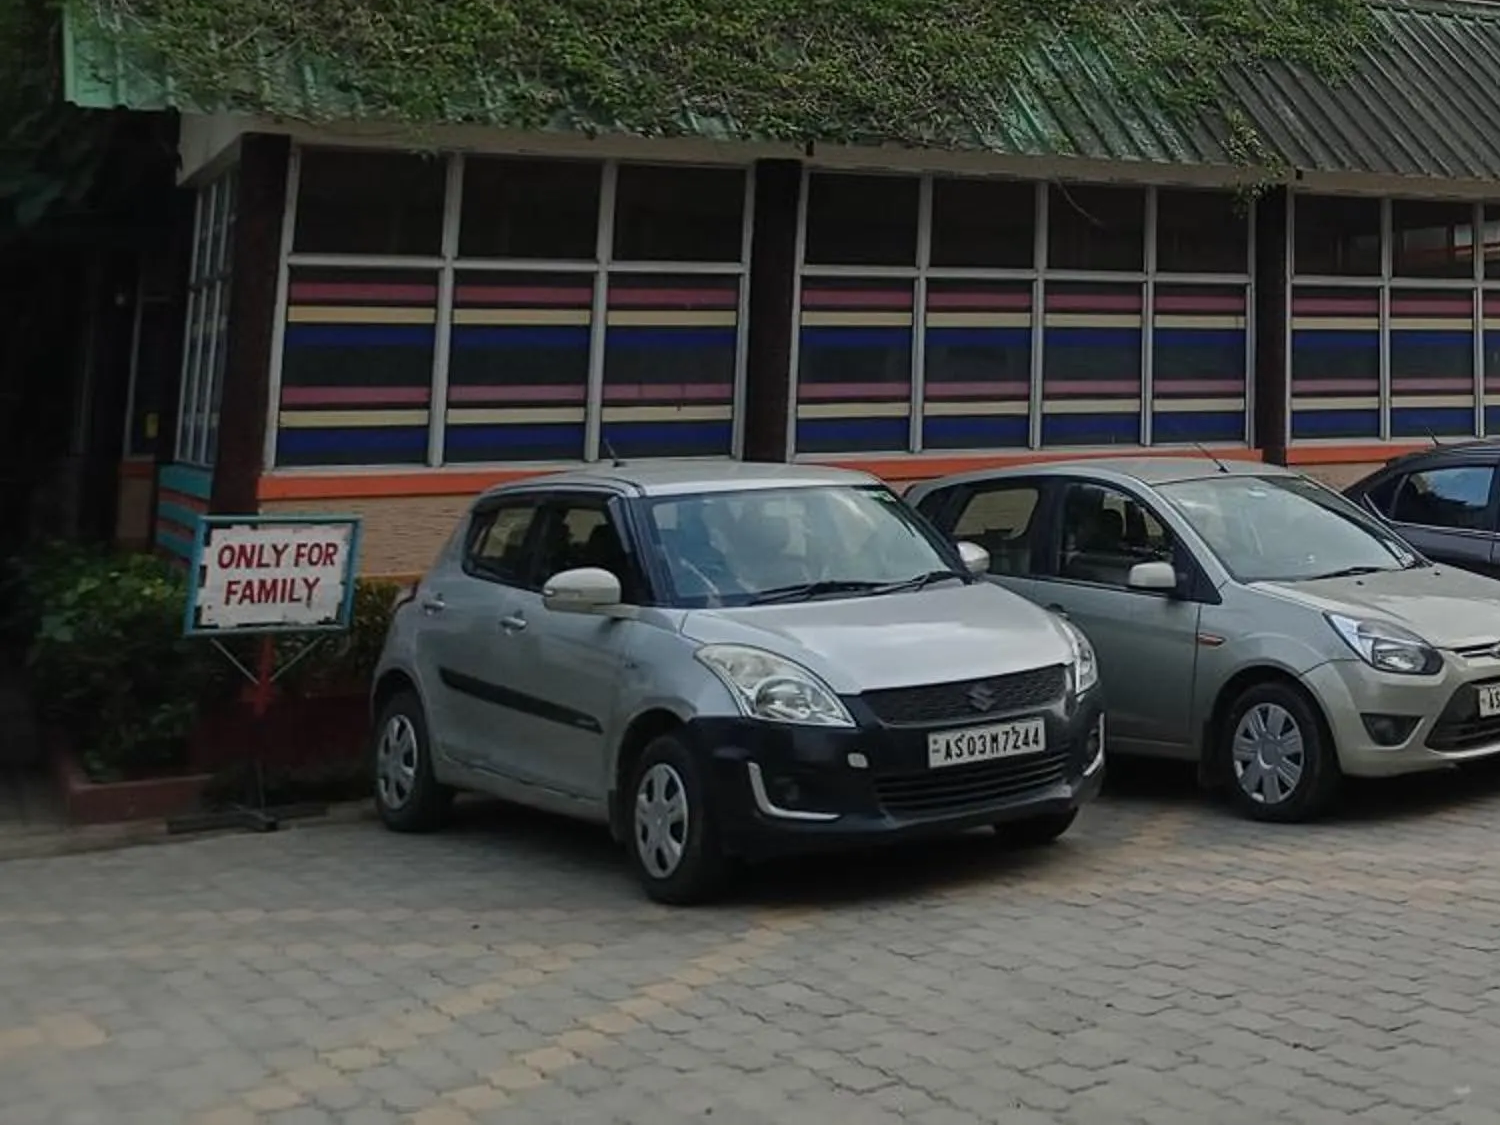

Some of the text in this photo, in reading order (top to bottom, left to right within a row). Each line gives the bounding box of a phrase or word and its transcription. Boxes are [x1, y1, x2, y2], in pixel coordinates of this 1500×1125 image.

[217, 542, 339, 569] ONLY FOR
[224, 577, 320, 606] FAMILY
[943, 726, 1040, 761] AS03M7244
